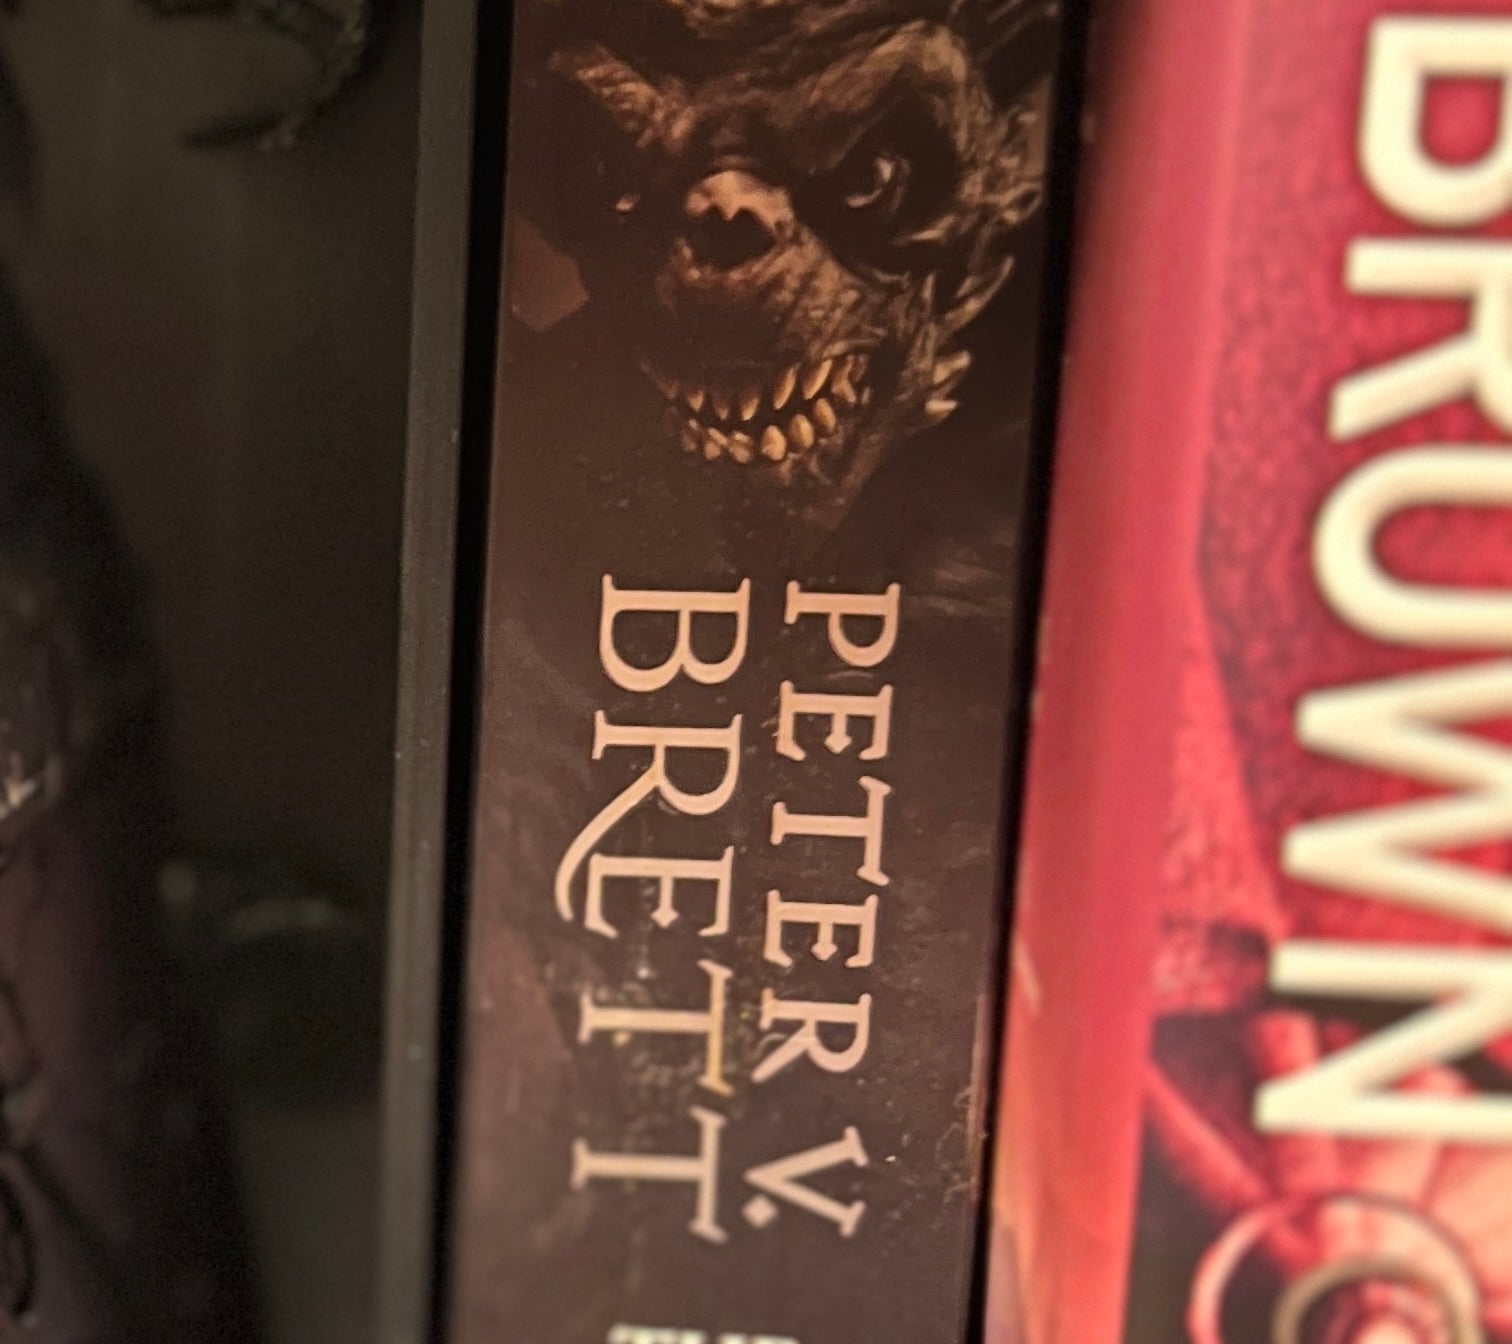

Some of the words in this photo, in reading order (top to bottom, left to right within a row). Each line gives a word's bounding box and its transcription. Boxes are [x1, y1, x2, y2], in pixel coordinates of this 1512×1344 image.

[554, 572, 752, 1245] BRETT
[751, 580, 901, 1083] PETER
[740, 1126, 868, 1238] V.
